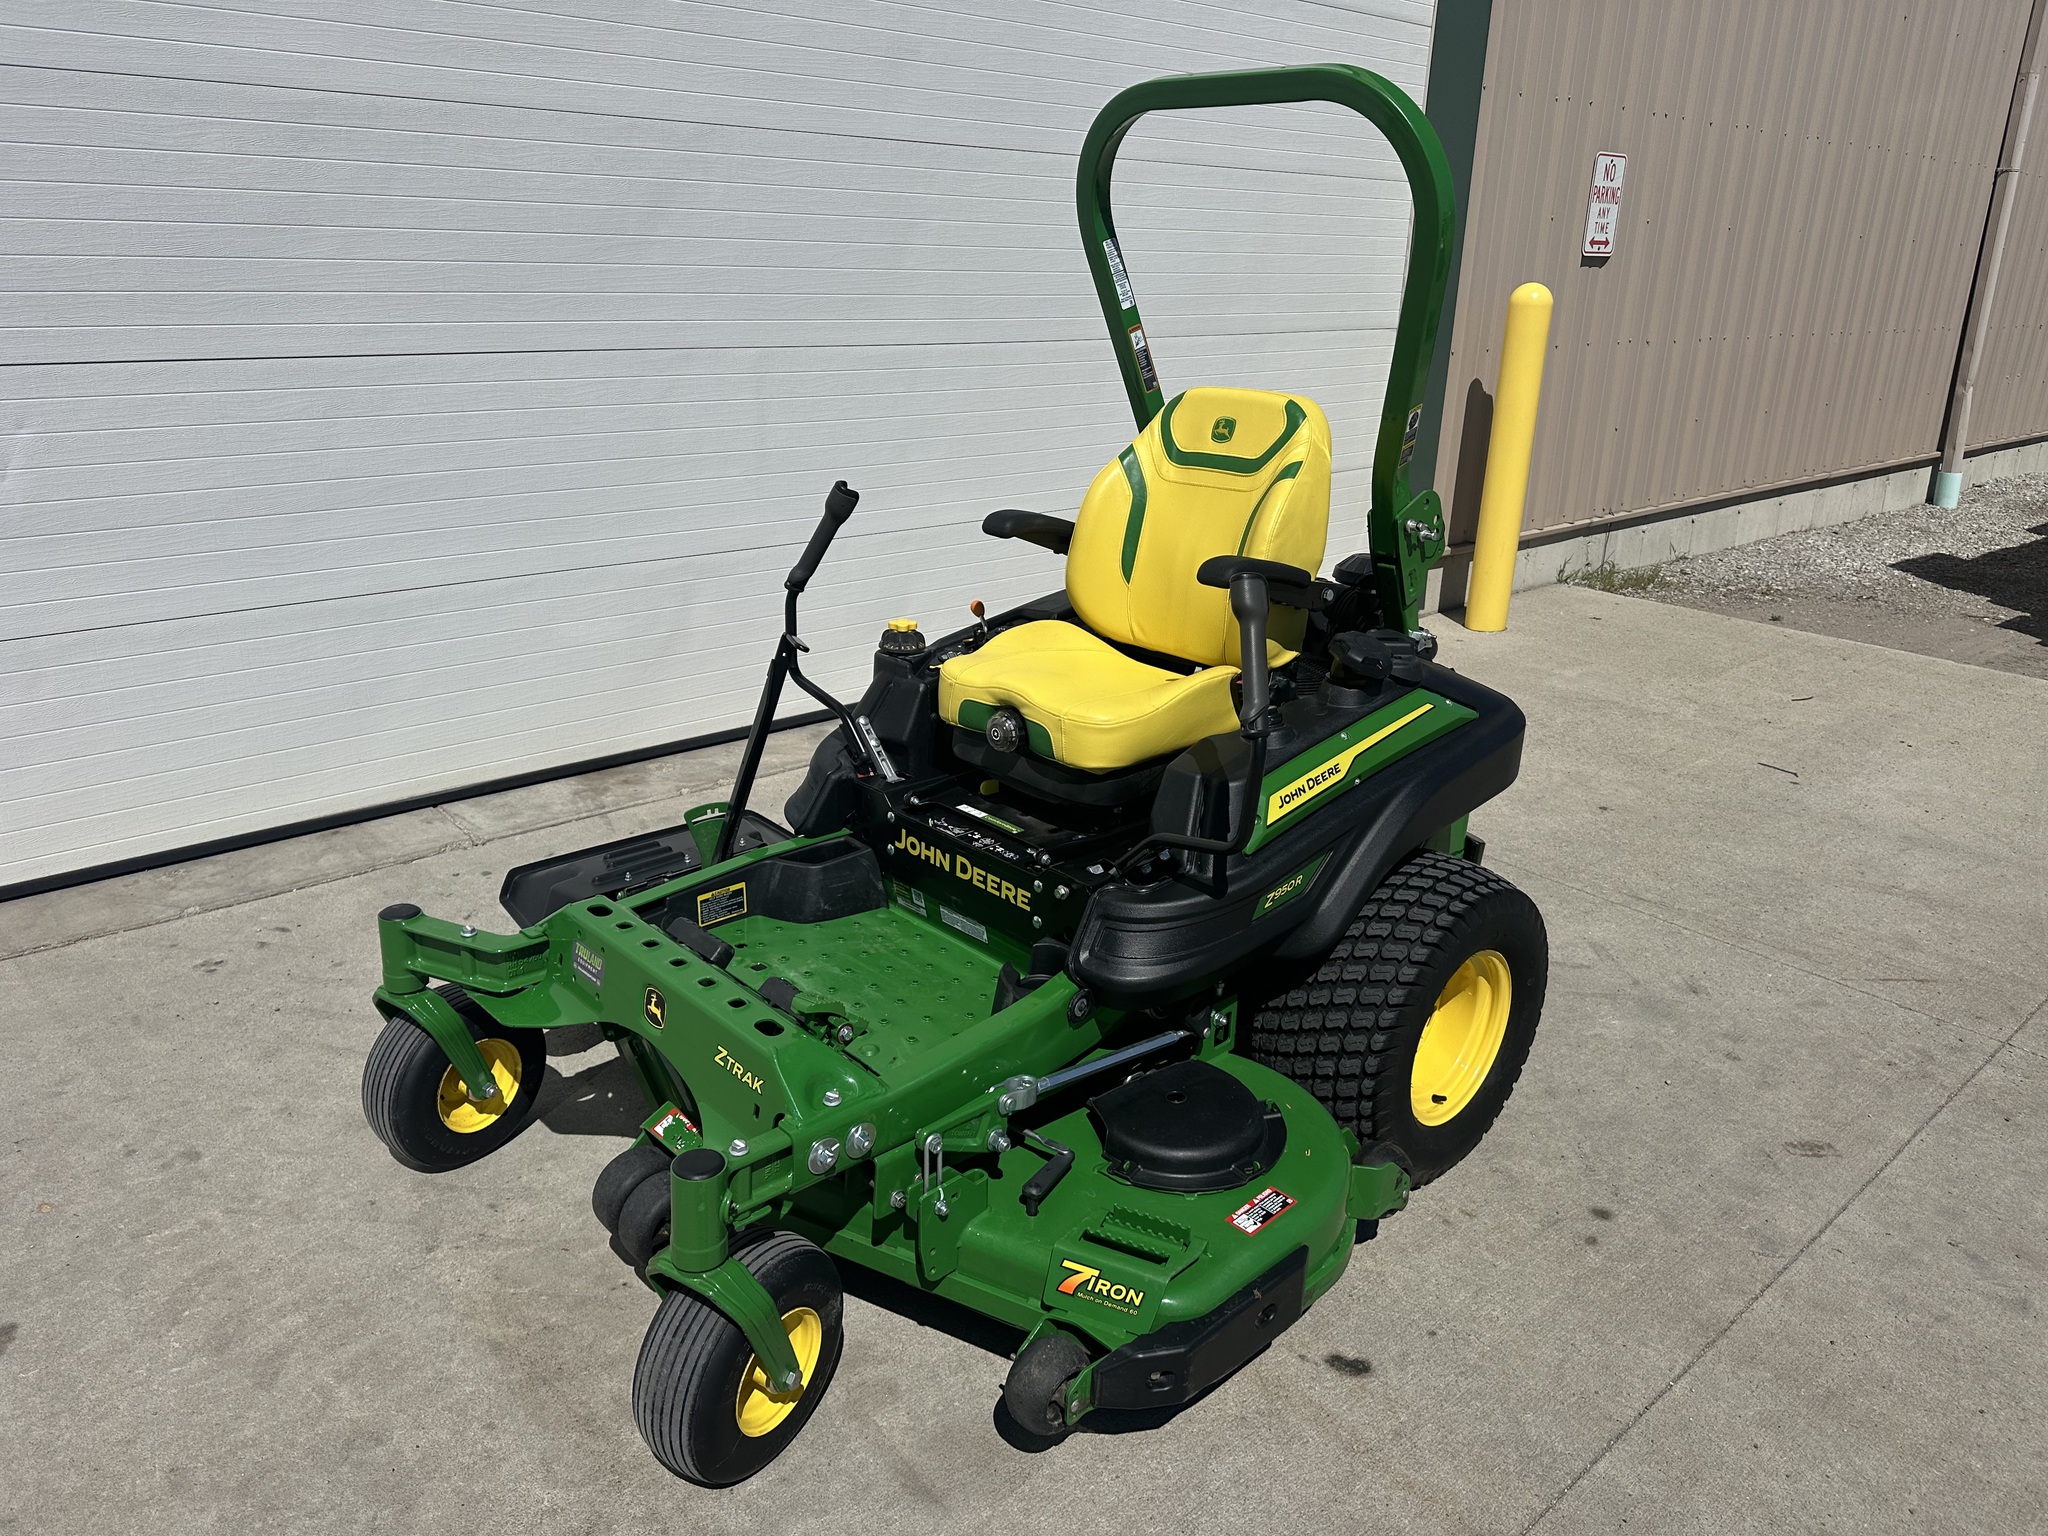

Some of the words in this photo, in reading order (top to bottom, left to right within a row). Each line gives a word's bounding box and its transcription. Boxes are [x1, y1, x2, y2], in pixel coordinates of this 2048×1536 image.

[1603, 163, 1617, 182] NO
[1591, 185, 1621, 205] PARKING
[1597, 207, 1611, 219] ANY
[1594, 222, 1610, 235] TIME
[1278, 784, 1306, 809] JOHN
[1306, 763, 1341, 791] DEERE
[894, 828, 950, 872] JOHN
[956, 854, 1032, 912] DEERE
[1264, 874, 1303, 909] Z950R
[714, 1045, 764, 1095] ZTRAK
[1077, 1292, 1094, 1301] Mulch
[1104, 1300, 1128, 1313] Demand
